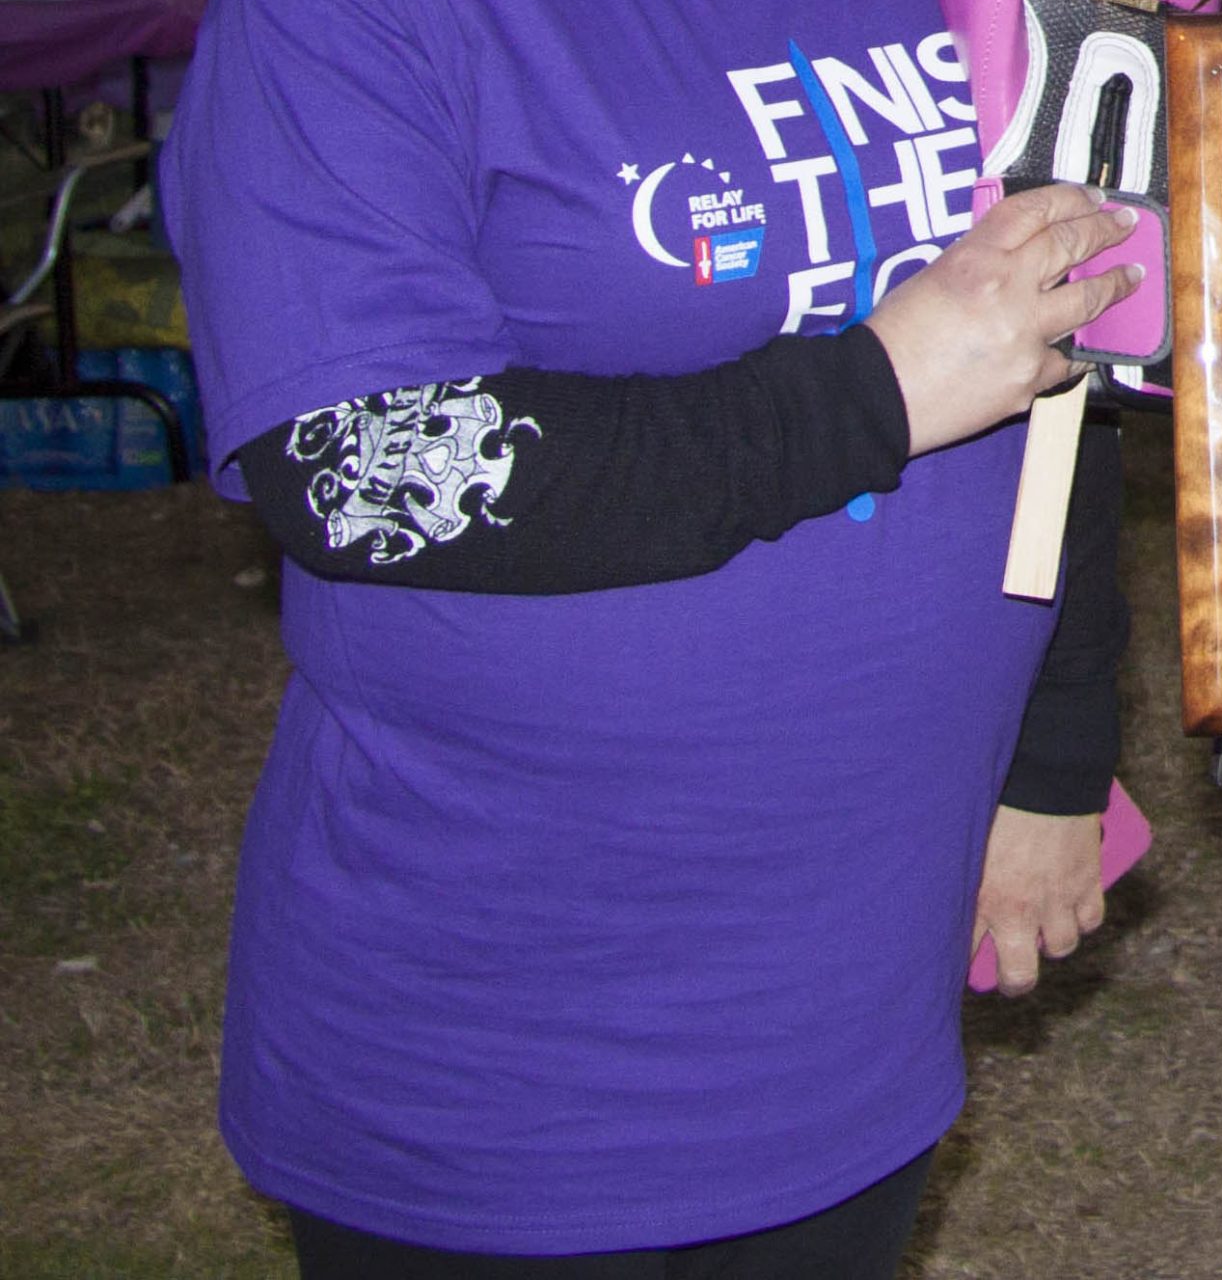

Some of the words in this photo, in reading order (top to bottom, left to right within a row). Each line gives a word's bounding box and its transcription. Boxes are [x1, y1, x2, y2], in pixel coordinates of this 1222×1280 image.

[688, 189, 743, 212] RELAY
[691, 210, 728, 230] FOR
[731, 203, 766, 224] LIFE
